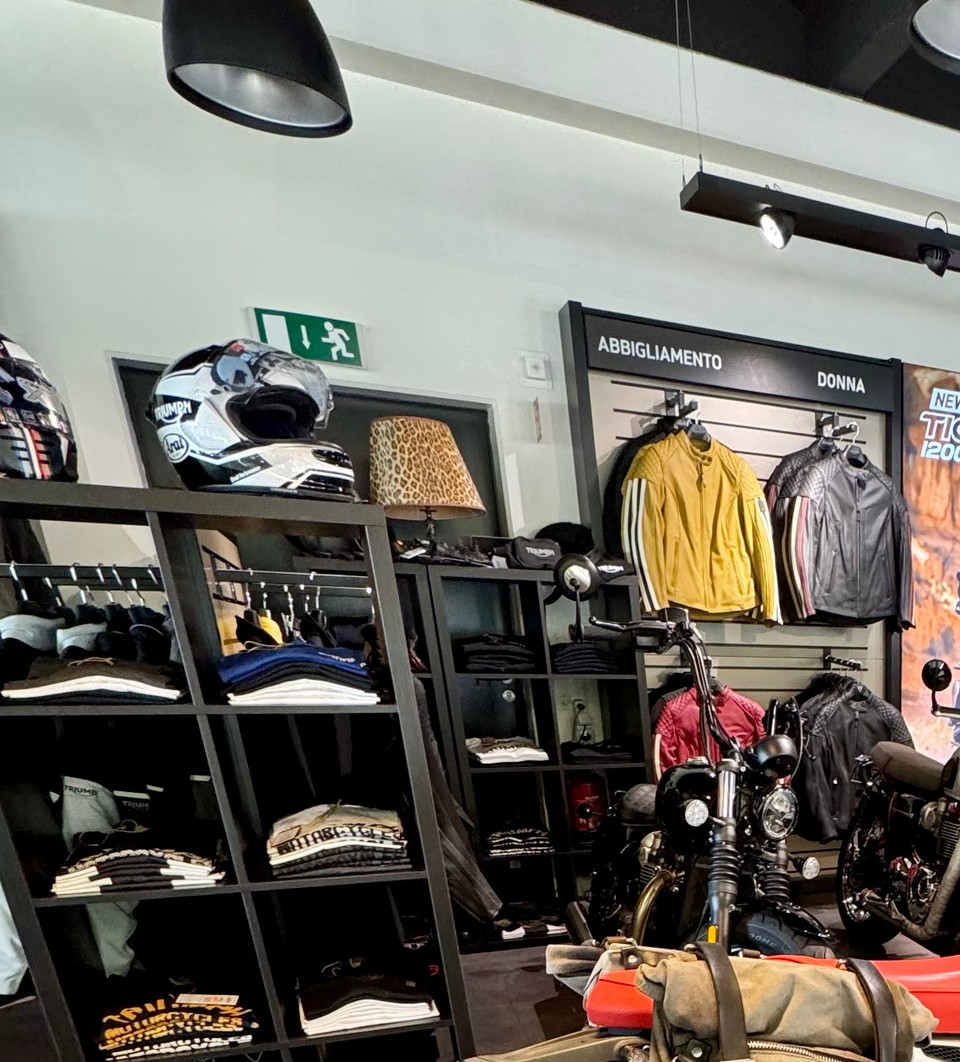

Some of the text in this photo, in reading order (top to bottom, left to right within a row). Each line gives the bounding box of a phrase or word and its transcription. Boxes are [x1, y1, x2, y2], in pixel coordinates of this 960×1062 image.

[598, 335, 866, 394] ABBIGLIAMENTO DONNA
[64, 783, 98, 797] TRIUMP
